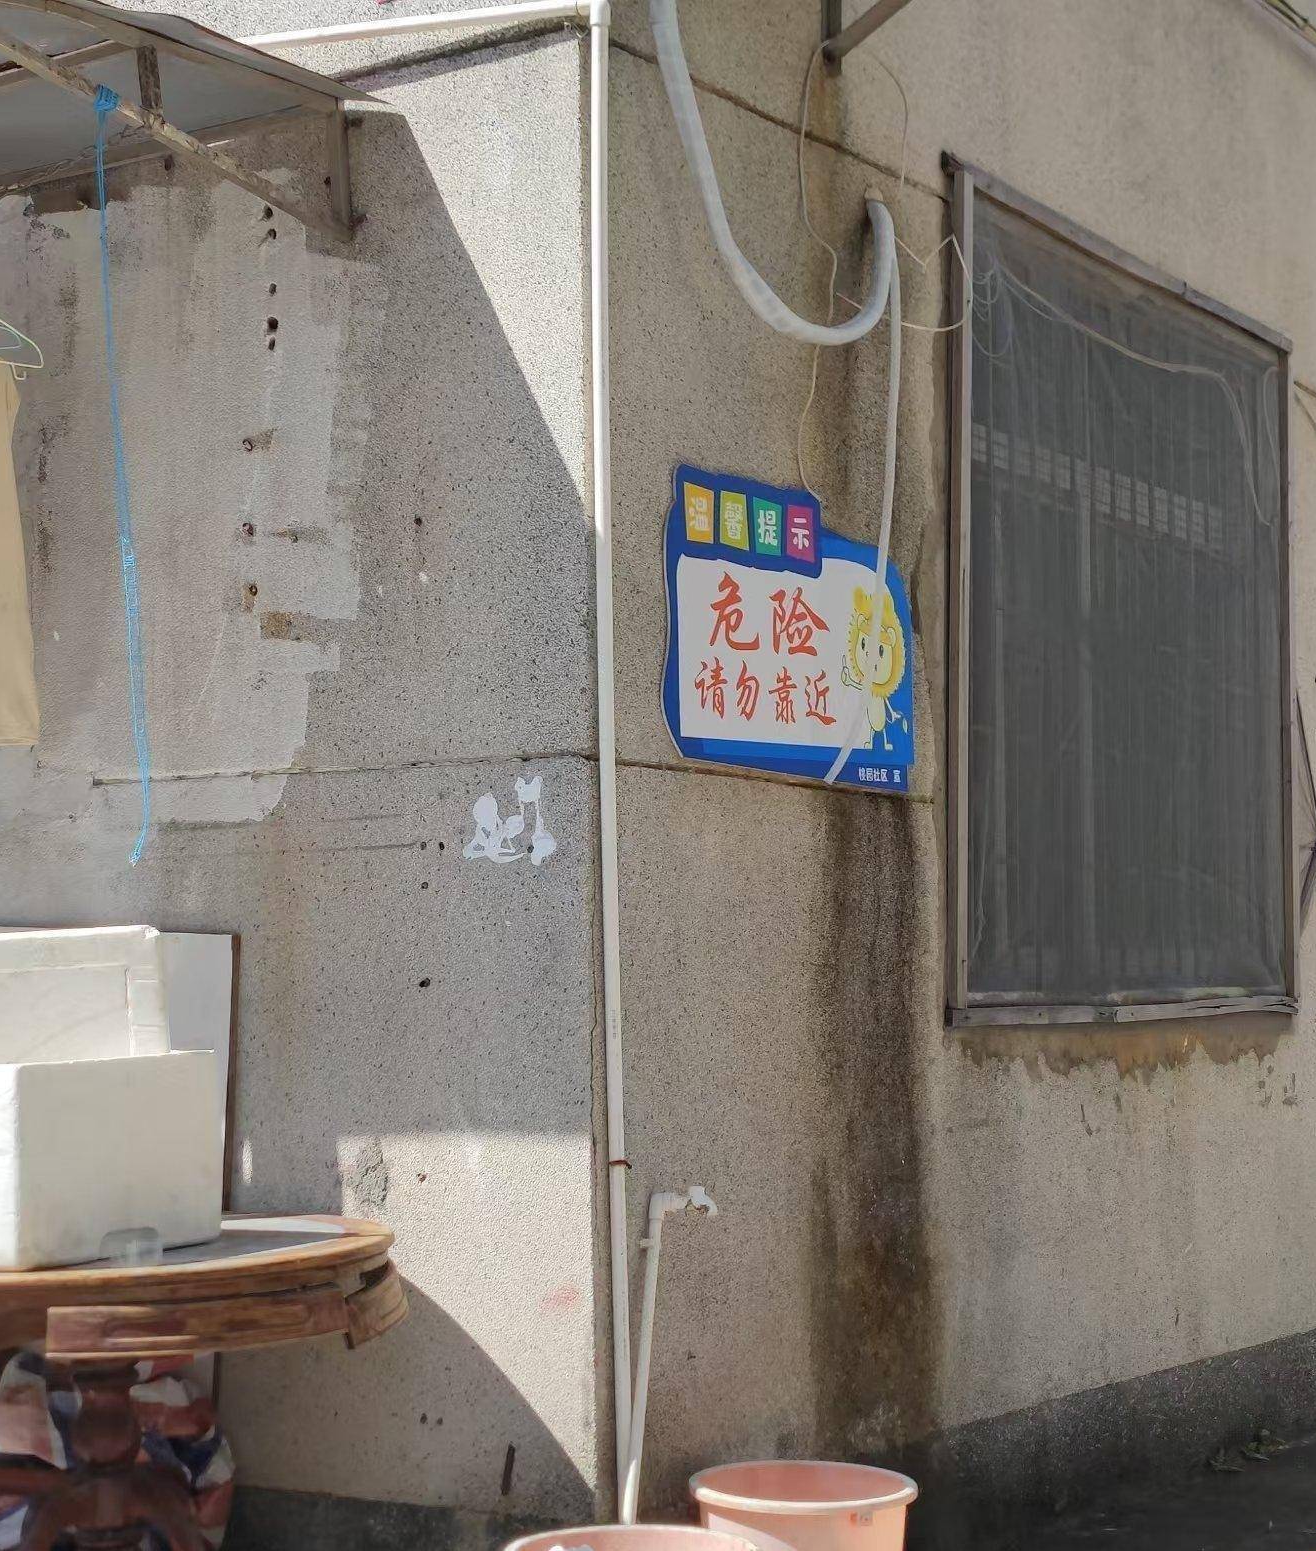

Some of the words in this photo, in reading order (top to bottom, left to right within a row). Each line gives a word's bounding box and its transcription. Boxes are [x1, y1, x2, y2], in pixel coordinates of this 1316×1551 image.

[709, 571, 831, 657] 危险
[694, 656, 837, 726] 请勿靠近
